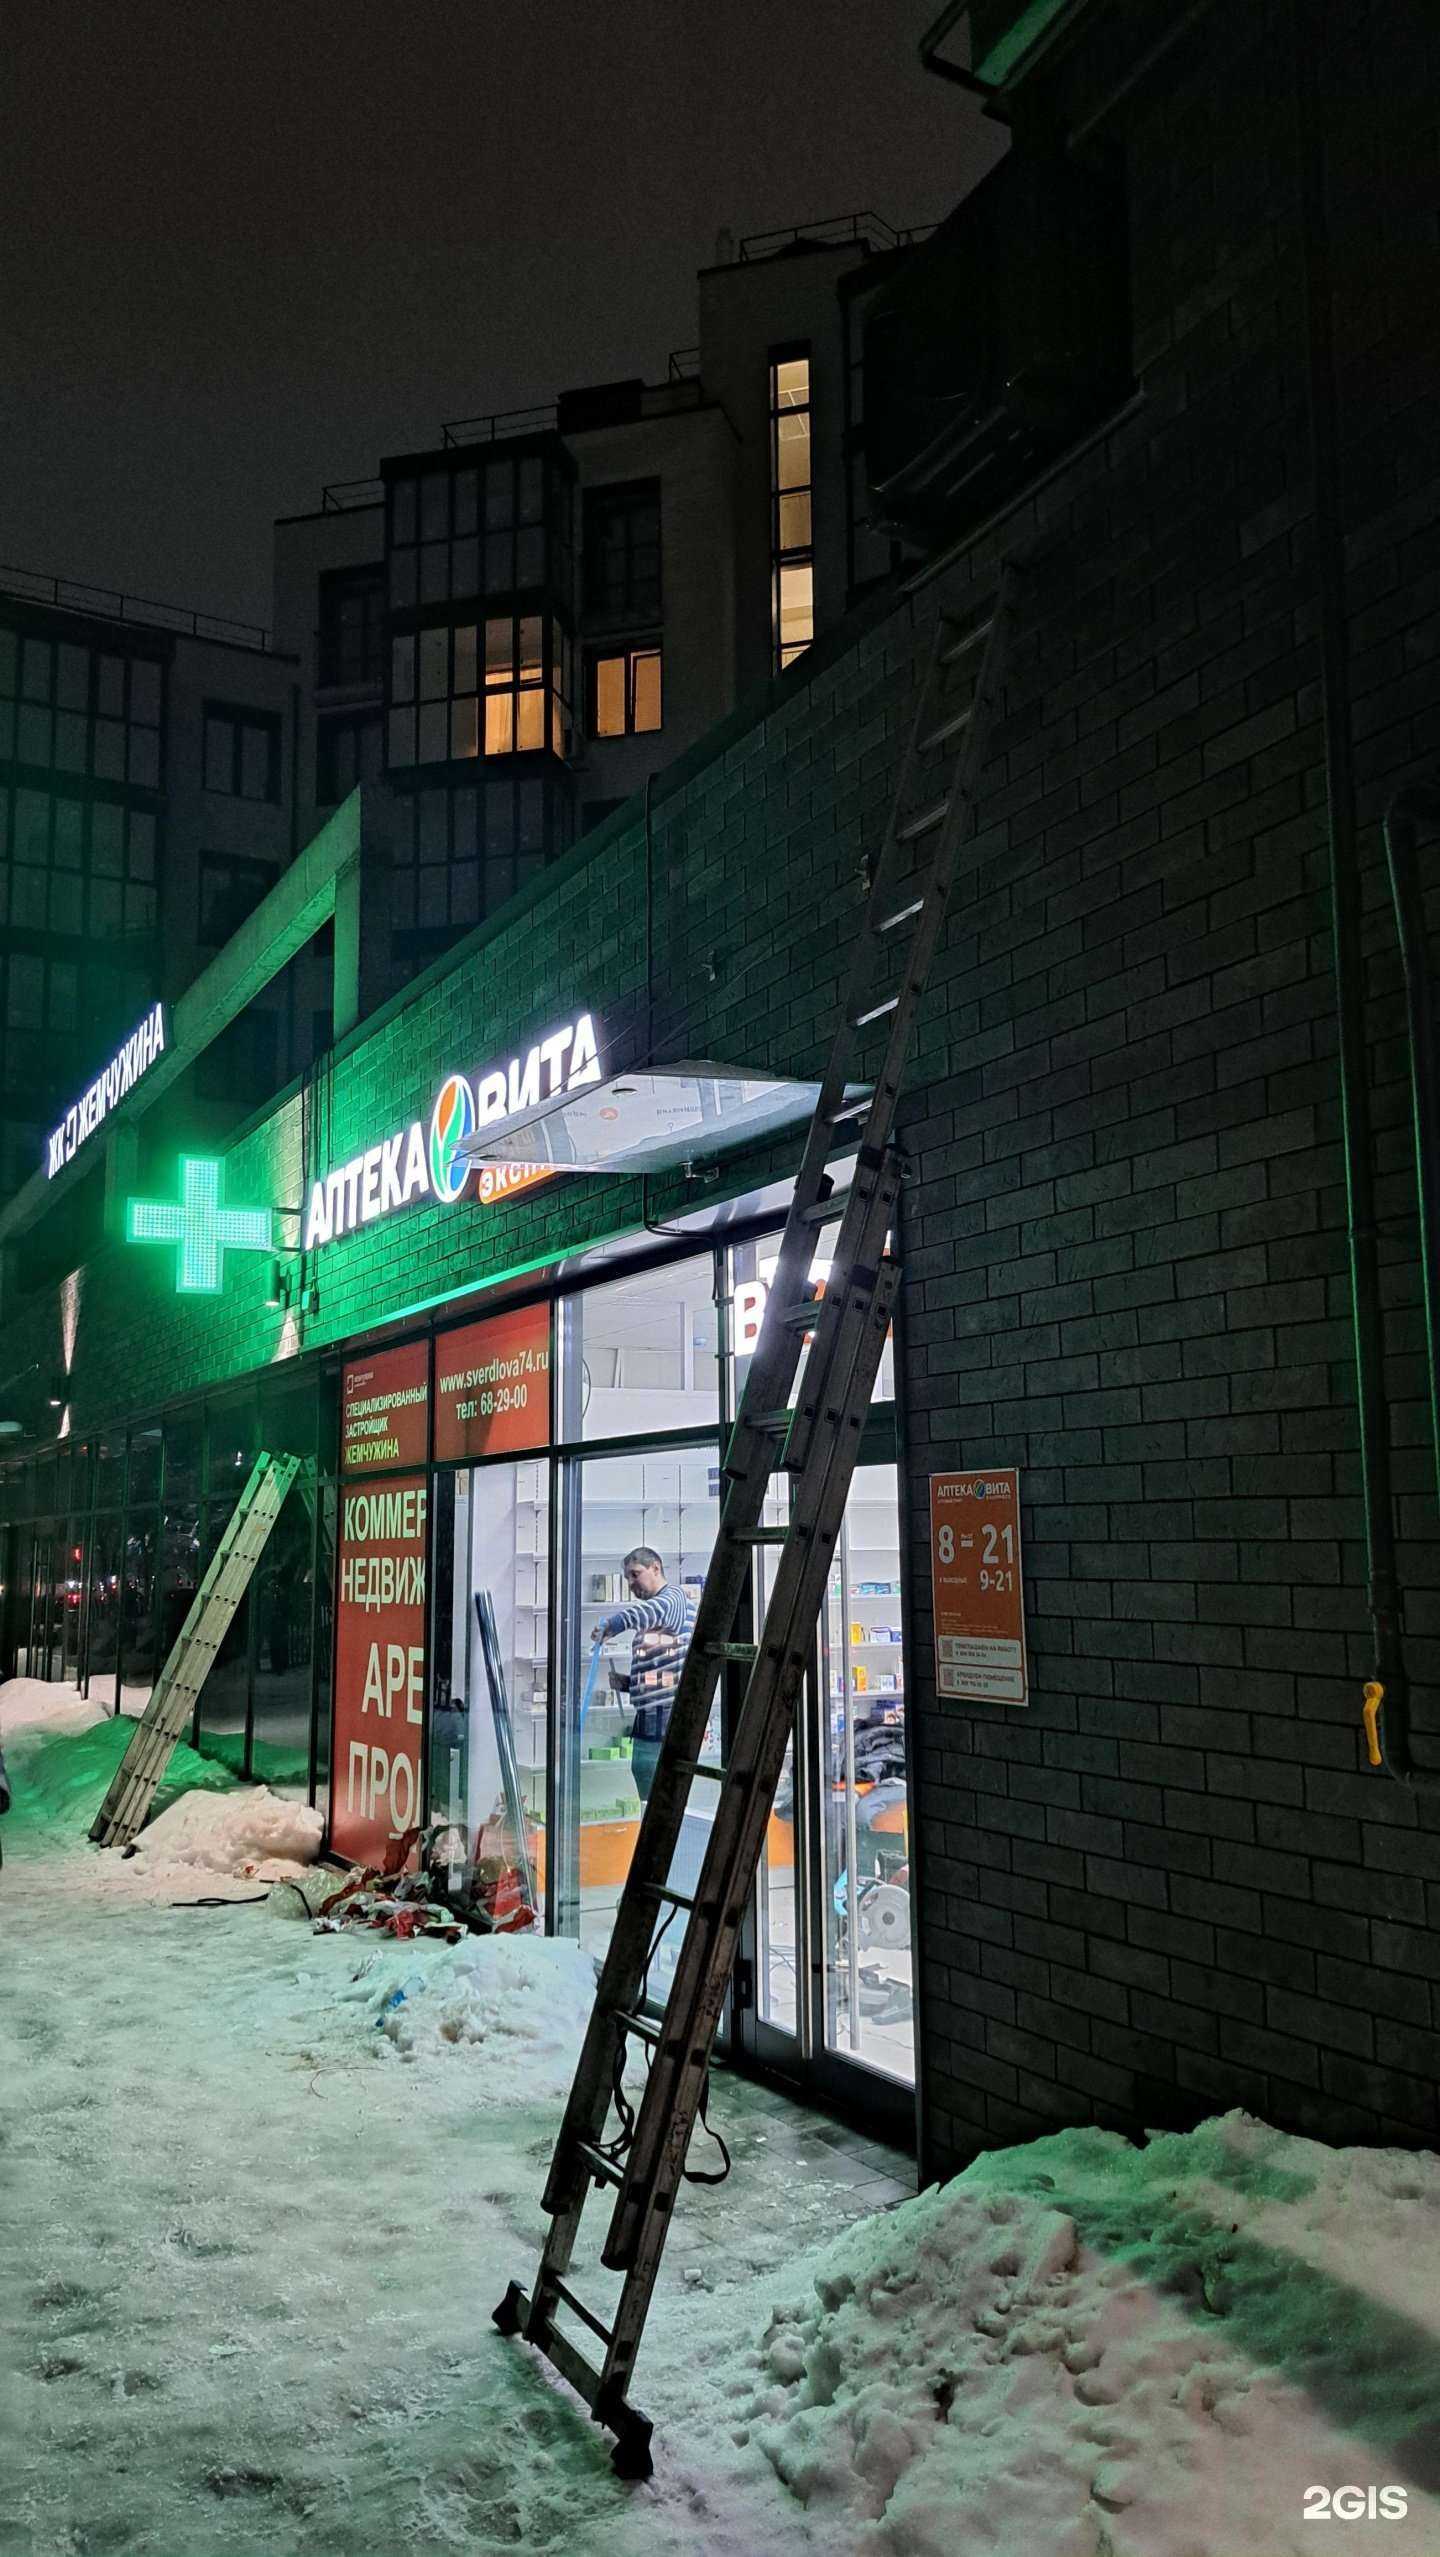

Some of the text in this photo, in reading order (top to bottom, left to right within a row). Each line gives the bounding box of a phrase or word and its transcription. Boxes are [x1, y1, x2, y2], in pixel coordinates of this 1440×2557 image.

[48, 1002, 164, 1180] ЖК ЖЕМЧУЖИНА
[305, 1013, 602, 1251] АПТЕКА ВИТА
[440, 1348, 549, 1394] www.sverdlova74.ru
[345, 1382, 428, 1418] СПЕЦИАЛИЗИРОВАННЫЙ
[456, 1383, 528, 1420] тел: 68-29-00
[345, 1415, 389, 1439] ЗАСТРОЙЩИК
[345, 1438, 400, 1465] ЖЕМЧУЖИНА
[937, 1485, 974, 1498] АПТЕКА
[985, 1481, 1011, 1496] ВИТА
[938, 1524, 955, 1564] 8
[981, 1523, 1014, 1564] 21
[341, 1555, 426, 1613] НЕДВИЖ
[979, 1569, 1013, 1592] 9-21
[361, 1642, 424, 1725] АРЕ
[347, 1740, 422, 1833] ПРО
